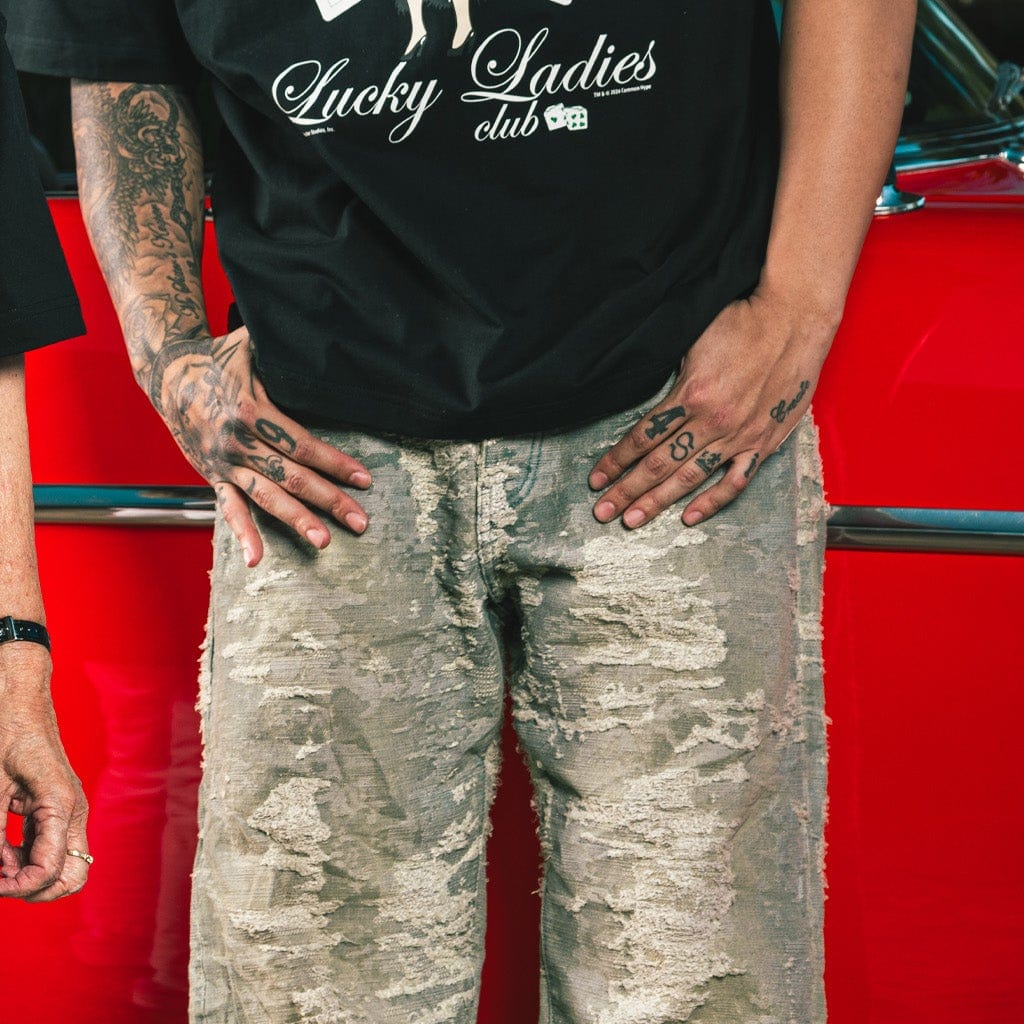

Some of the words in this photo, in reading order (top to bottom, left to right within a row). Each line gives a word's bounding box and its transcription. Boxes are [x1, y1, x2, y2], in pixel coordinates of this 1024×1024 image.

[271, 57, 443, 144] Lucky
[461, 27, 657, 103] Ladies
[474, 99, 539, 142] club
